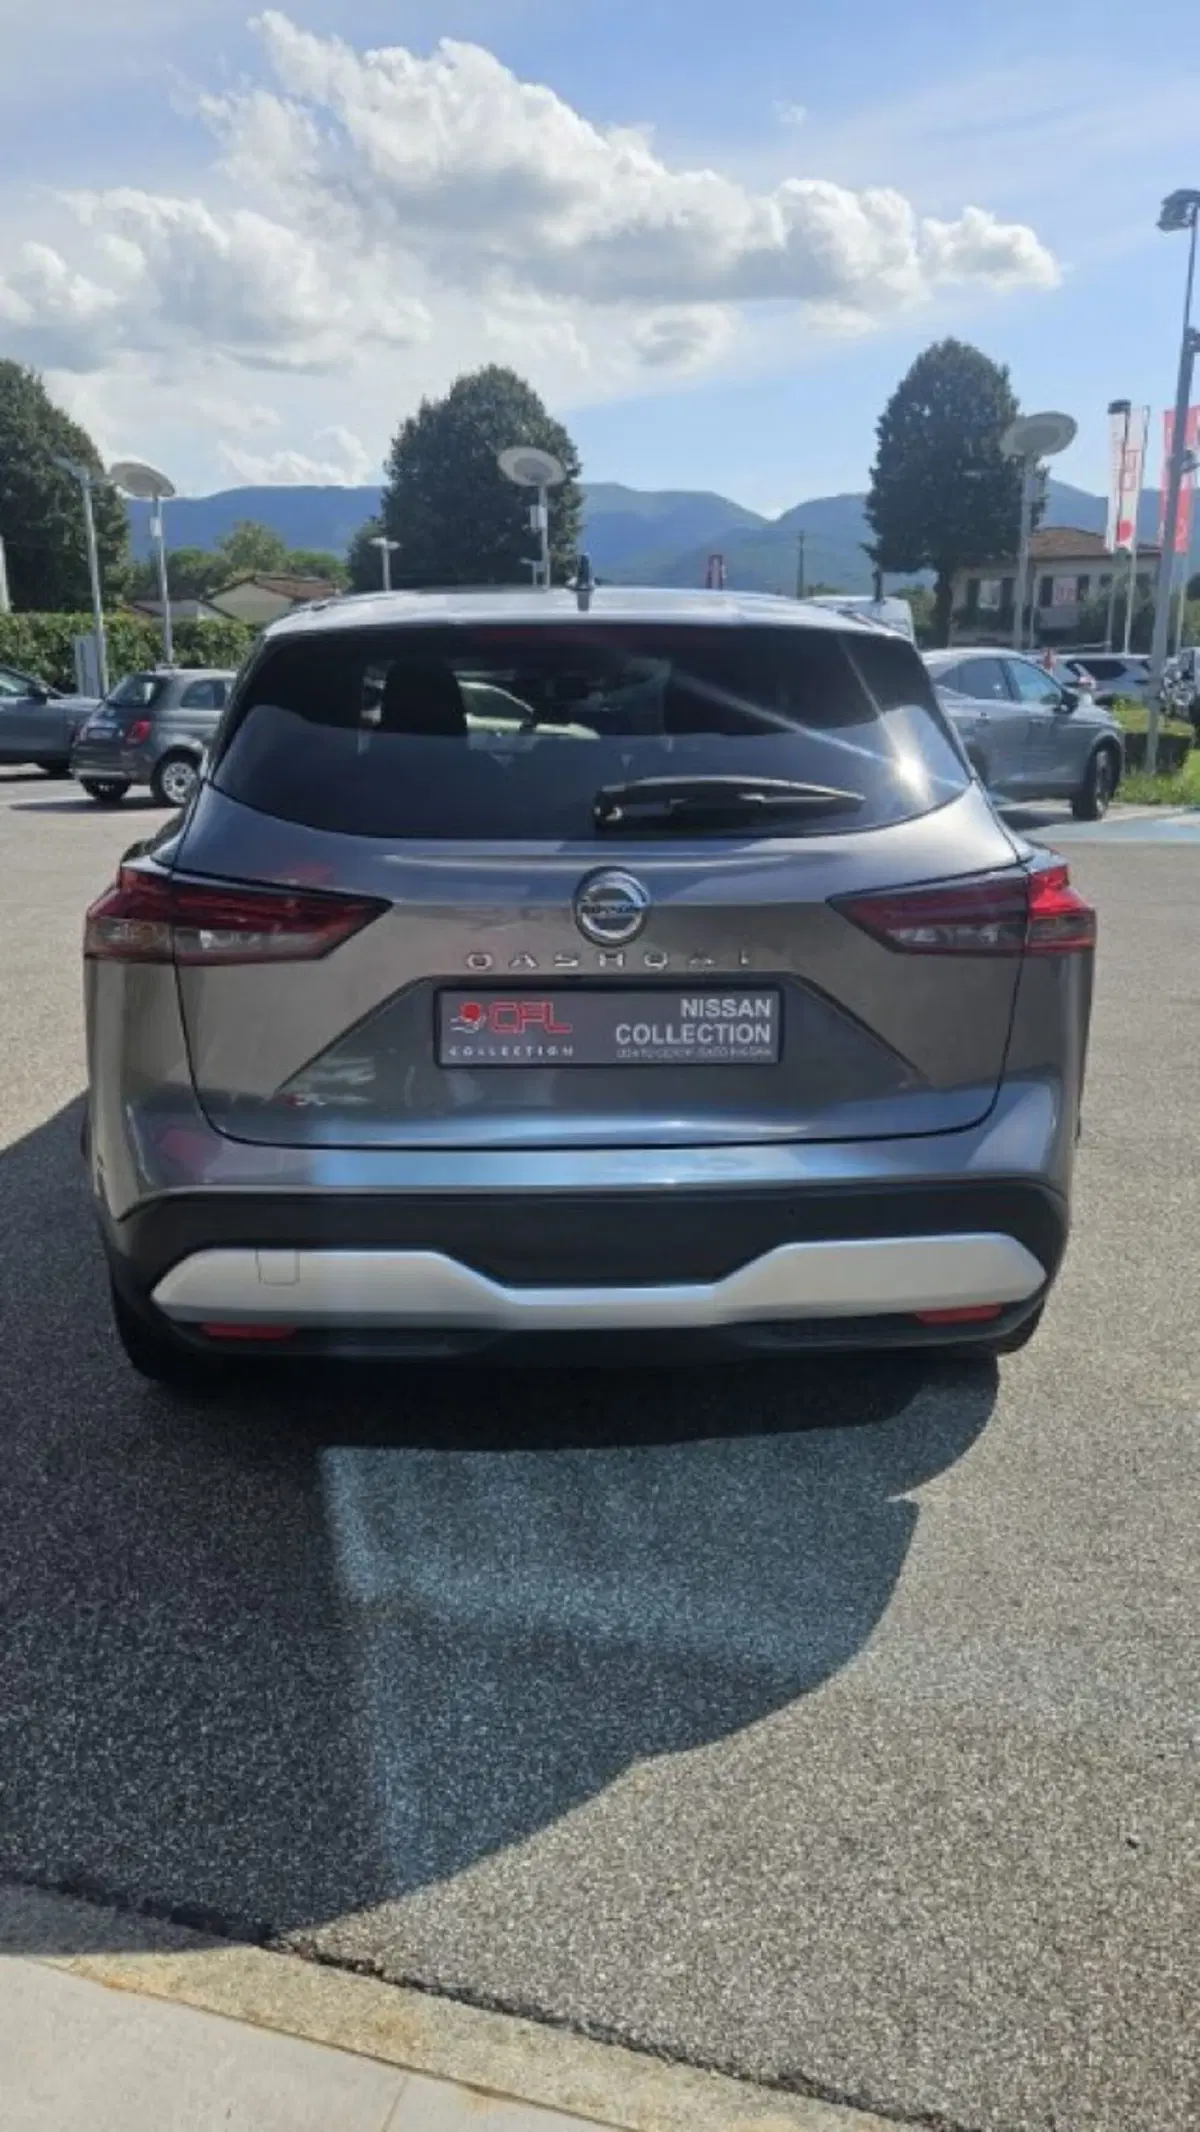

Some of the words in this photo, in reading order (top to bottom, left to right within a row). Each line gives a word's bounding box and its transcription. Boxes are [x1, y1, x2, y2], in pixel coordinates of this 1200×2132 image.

[680, 998, 772, 1018] NISSAN
[615, 1023, 772, 1045] COLLECTION
[448, 1045, 574, 1057] COLLECTION
